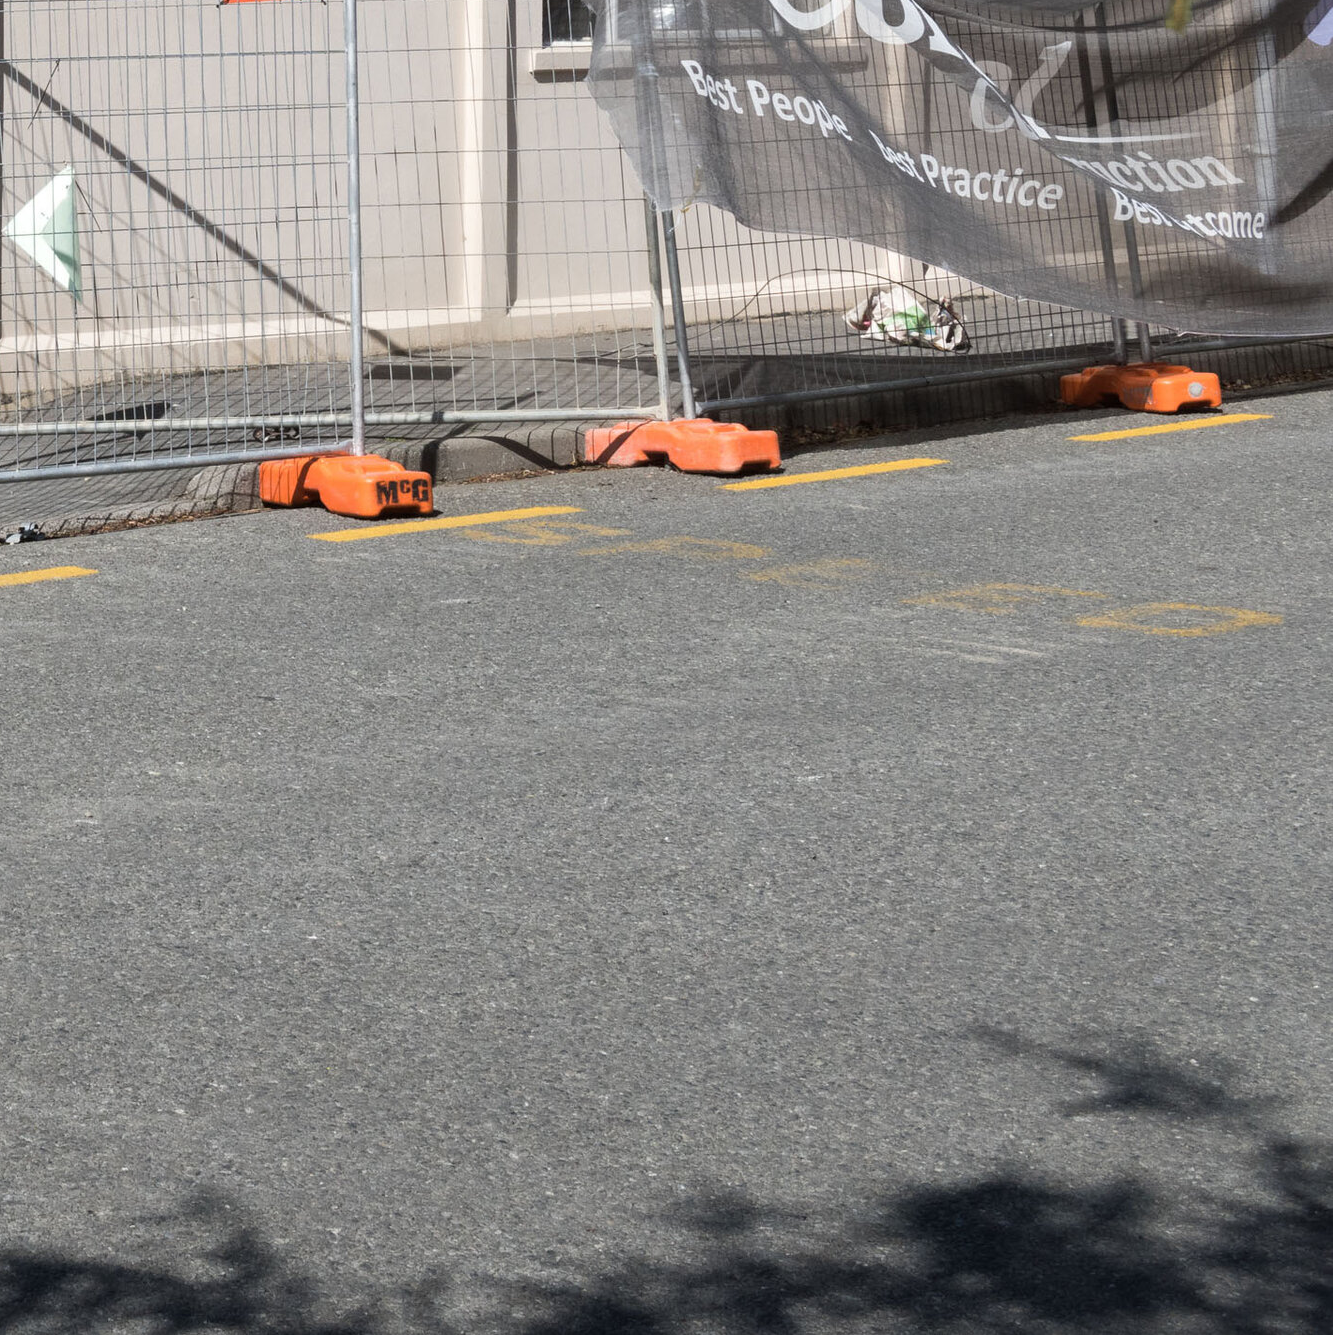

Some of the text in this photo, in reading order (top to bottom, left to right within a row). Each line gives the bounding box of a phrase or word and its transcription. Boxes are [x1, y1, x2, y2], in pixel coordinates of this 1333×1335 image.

[680, 59, 744, 115] Best
[920, 153, 1064, 210] Practice
[375, 478, 429, 505] McG
